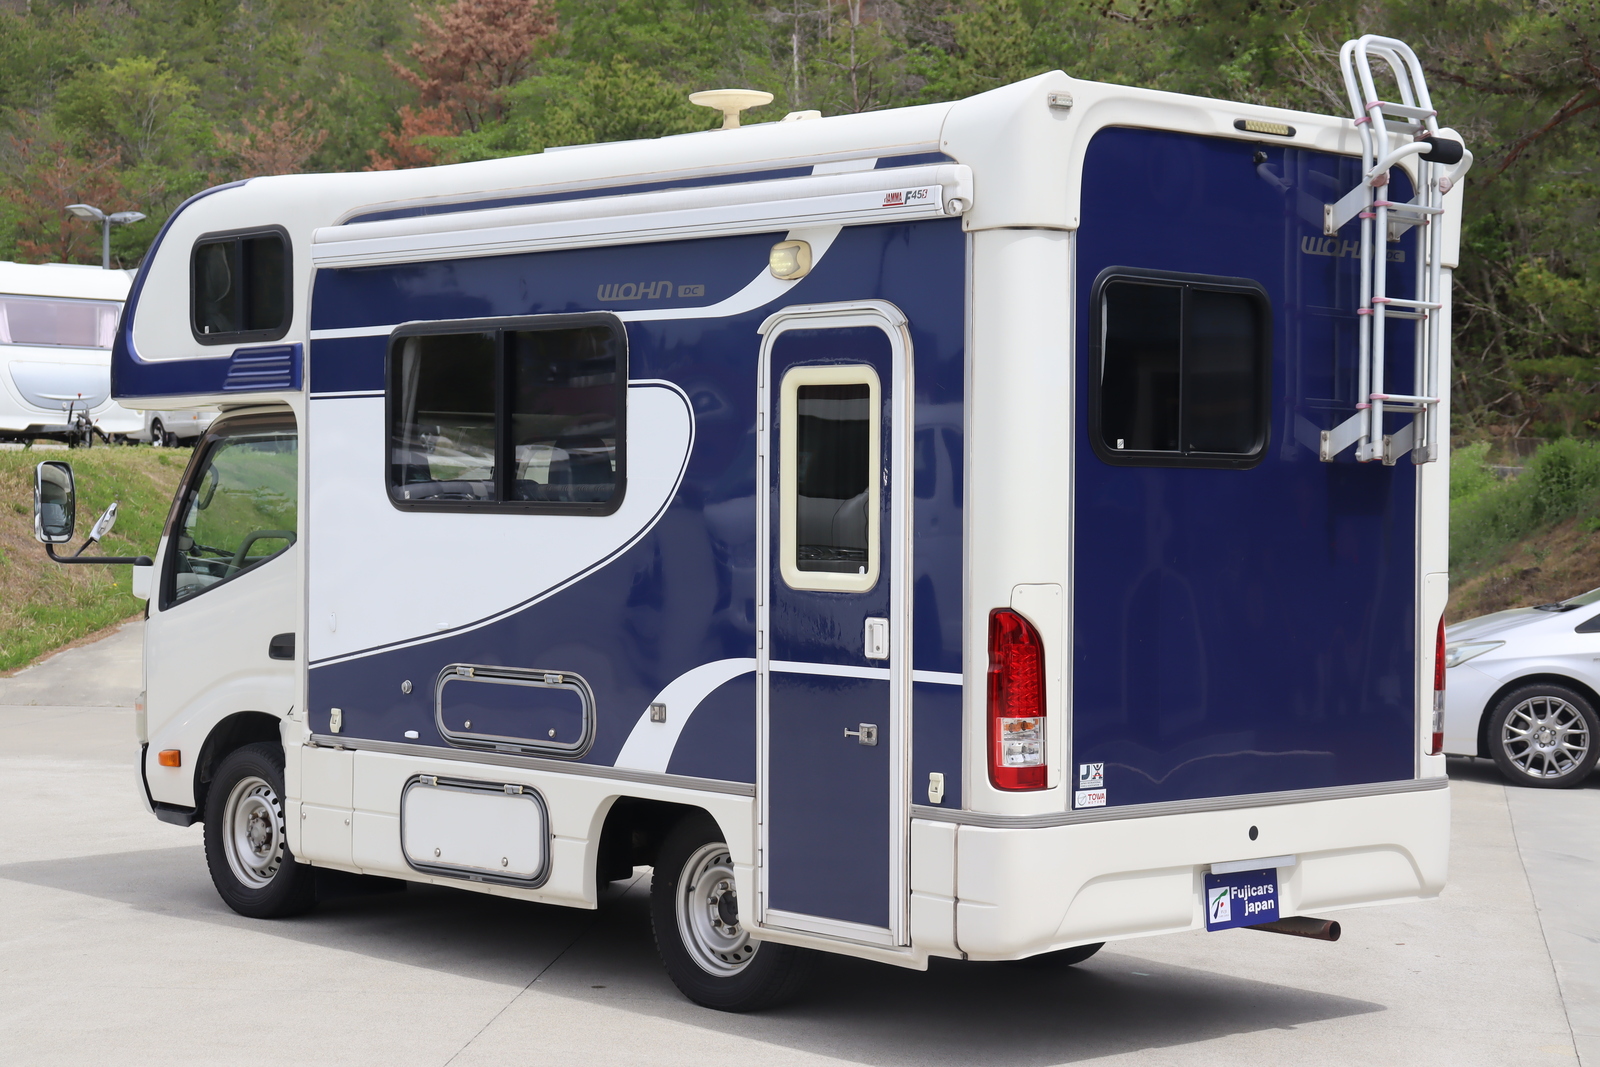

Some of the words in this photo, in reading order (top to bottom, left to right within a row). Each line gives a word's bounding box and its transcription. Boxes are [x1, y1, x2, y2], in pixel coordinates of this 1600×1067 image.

[597, 281, 673, 301] WOHN
[682, 286, 700, 296] DC
[1231, 884, 1274, 900] Fujicars
[1244, 899, 1275, 916] japan
